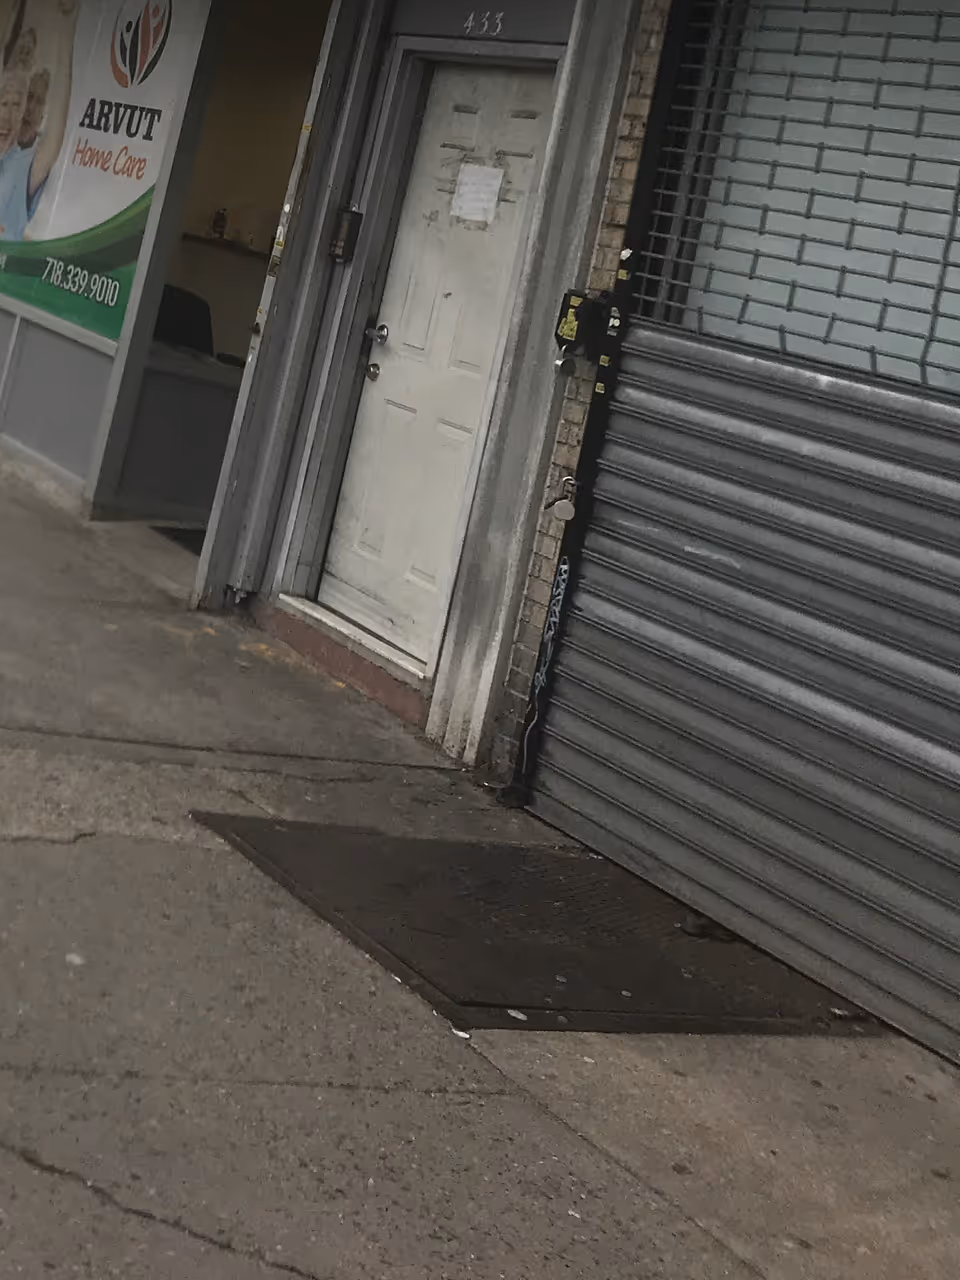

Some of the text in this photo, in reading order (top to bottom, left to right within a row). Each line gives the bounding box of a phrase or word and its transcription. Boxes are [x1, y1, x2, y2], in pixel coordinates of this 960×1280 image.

[463, 11, 505, 36] 433
[79, 98, 162, 141] ARVUT
[72, 139, 147, 180] Home Care
[42, 256, 120, 307] 718.339.9010
